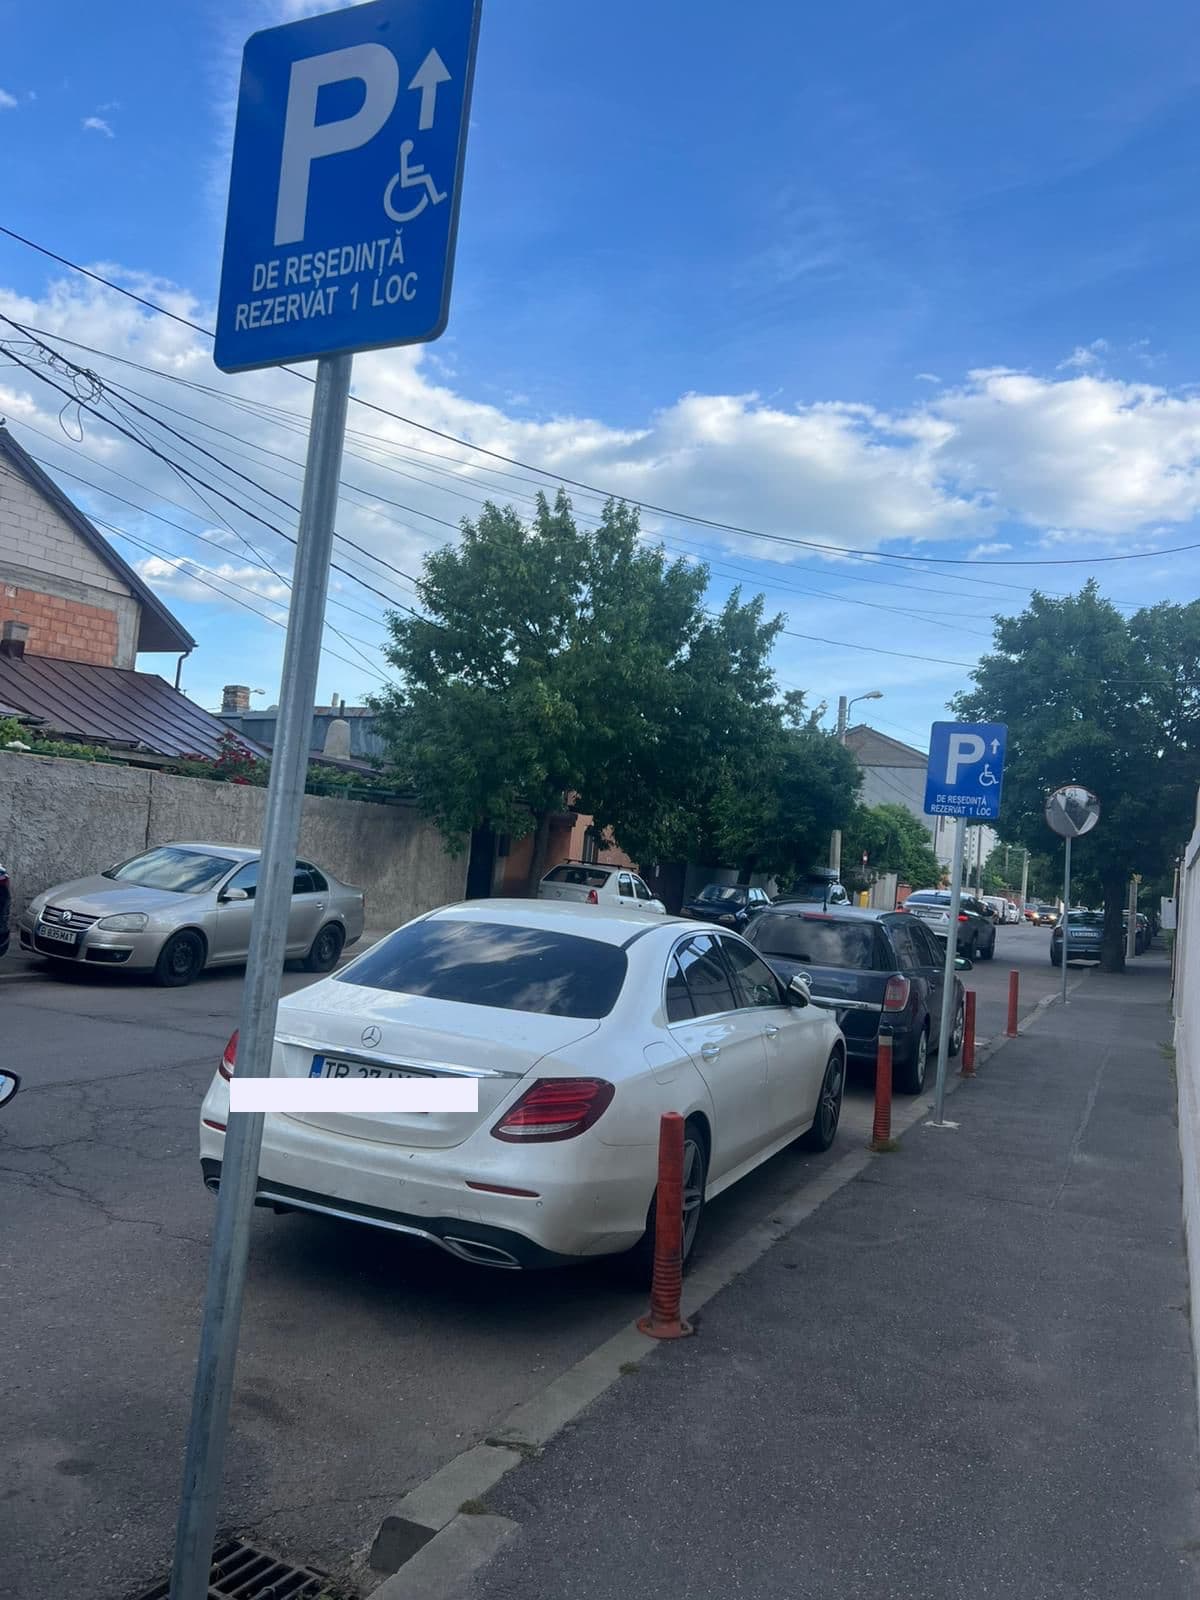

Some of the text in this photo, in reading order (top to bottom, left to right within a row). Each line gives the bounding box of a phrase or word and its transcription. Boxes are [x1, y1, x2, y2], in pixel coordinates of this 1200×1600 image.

[274, 43, 400, 247] P
[252, 260, 279, 292] DE
[235, 271, 418, 331] REZERVAT 1 LOC
[945, 733, 986, 784] P
[930, 804, 966, 814] REZERVAT
[976, 807, 992, 816] LOC
[936, 794, 946, 803] DE
